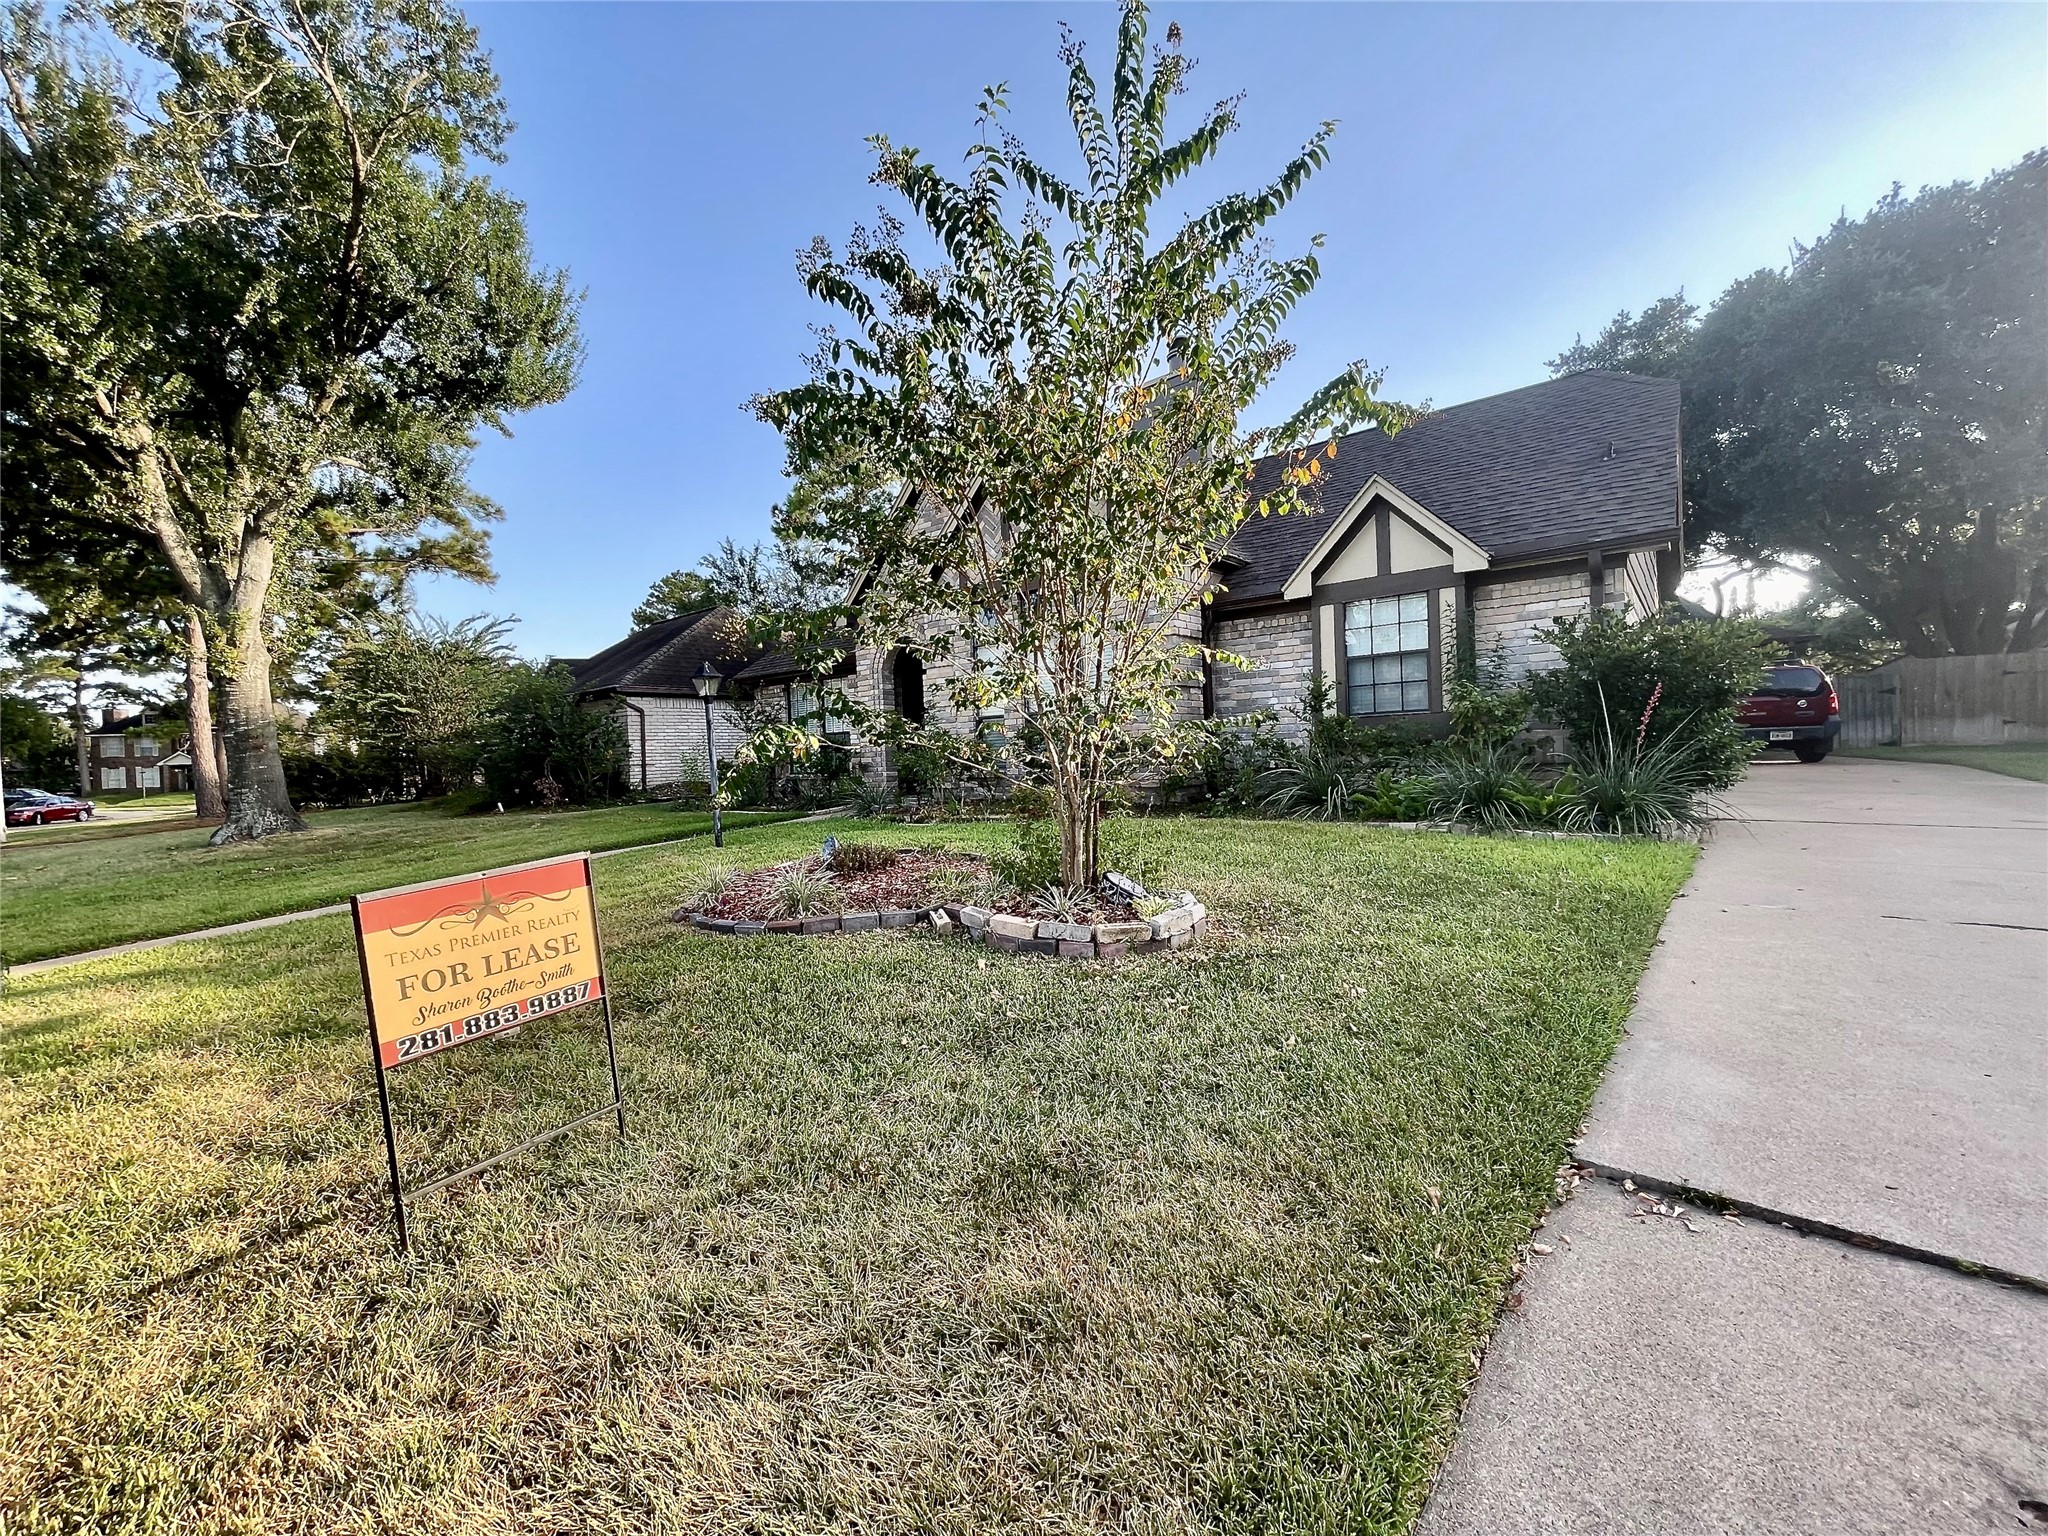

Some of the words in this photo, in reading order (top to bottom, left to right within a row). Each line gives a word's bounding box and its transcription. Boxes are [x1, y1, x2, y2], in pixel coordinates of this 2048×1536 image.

[396, 962, 473, 1002] FOR
[481, 932, 581, 978] LEASE
[412, 996, 473, 1027] Sharon
[476, 962, 575, 1010] Boothe-Smith
[396, 981, 591, 1061] 281.883.9887
